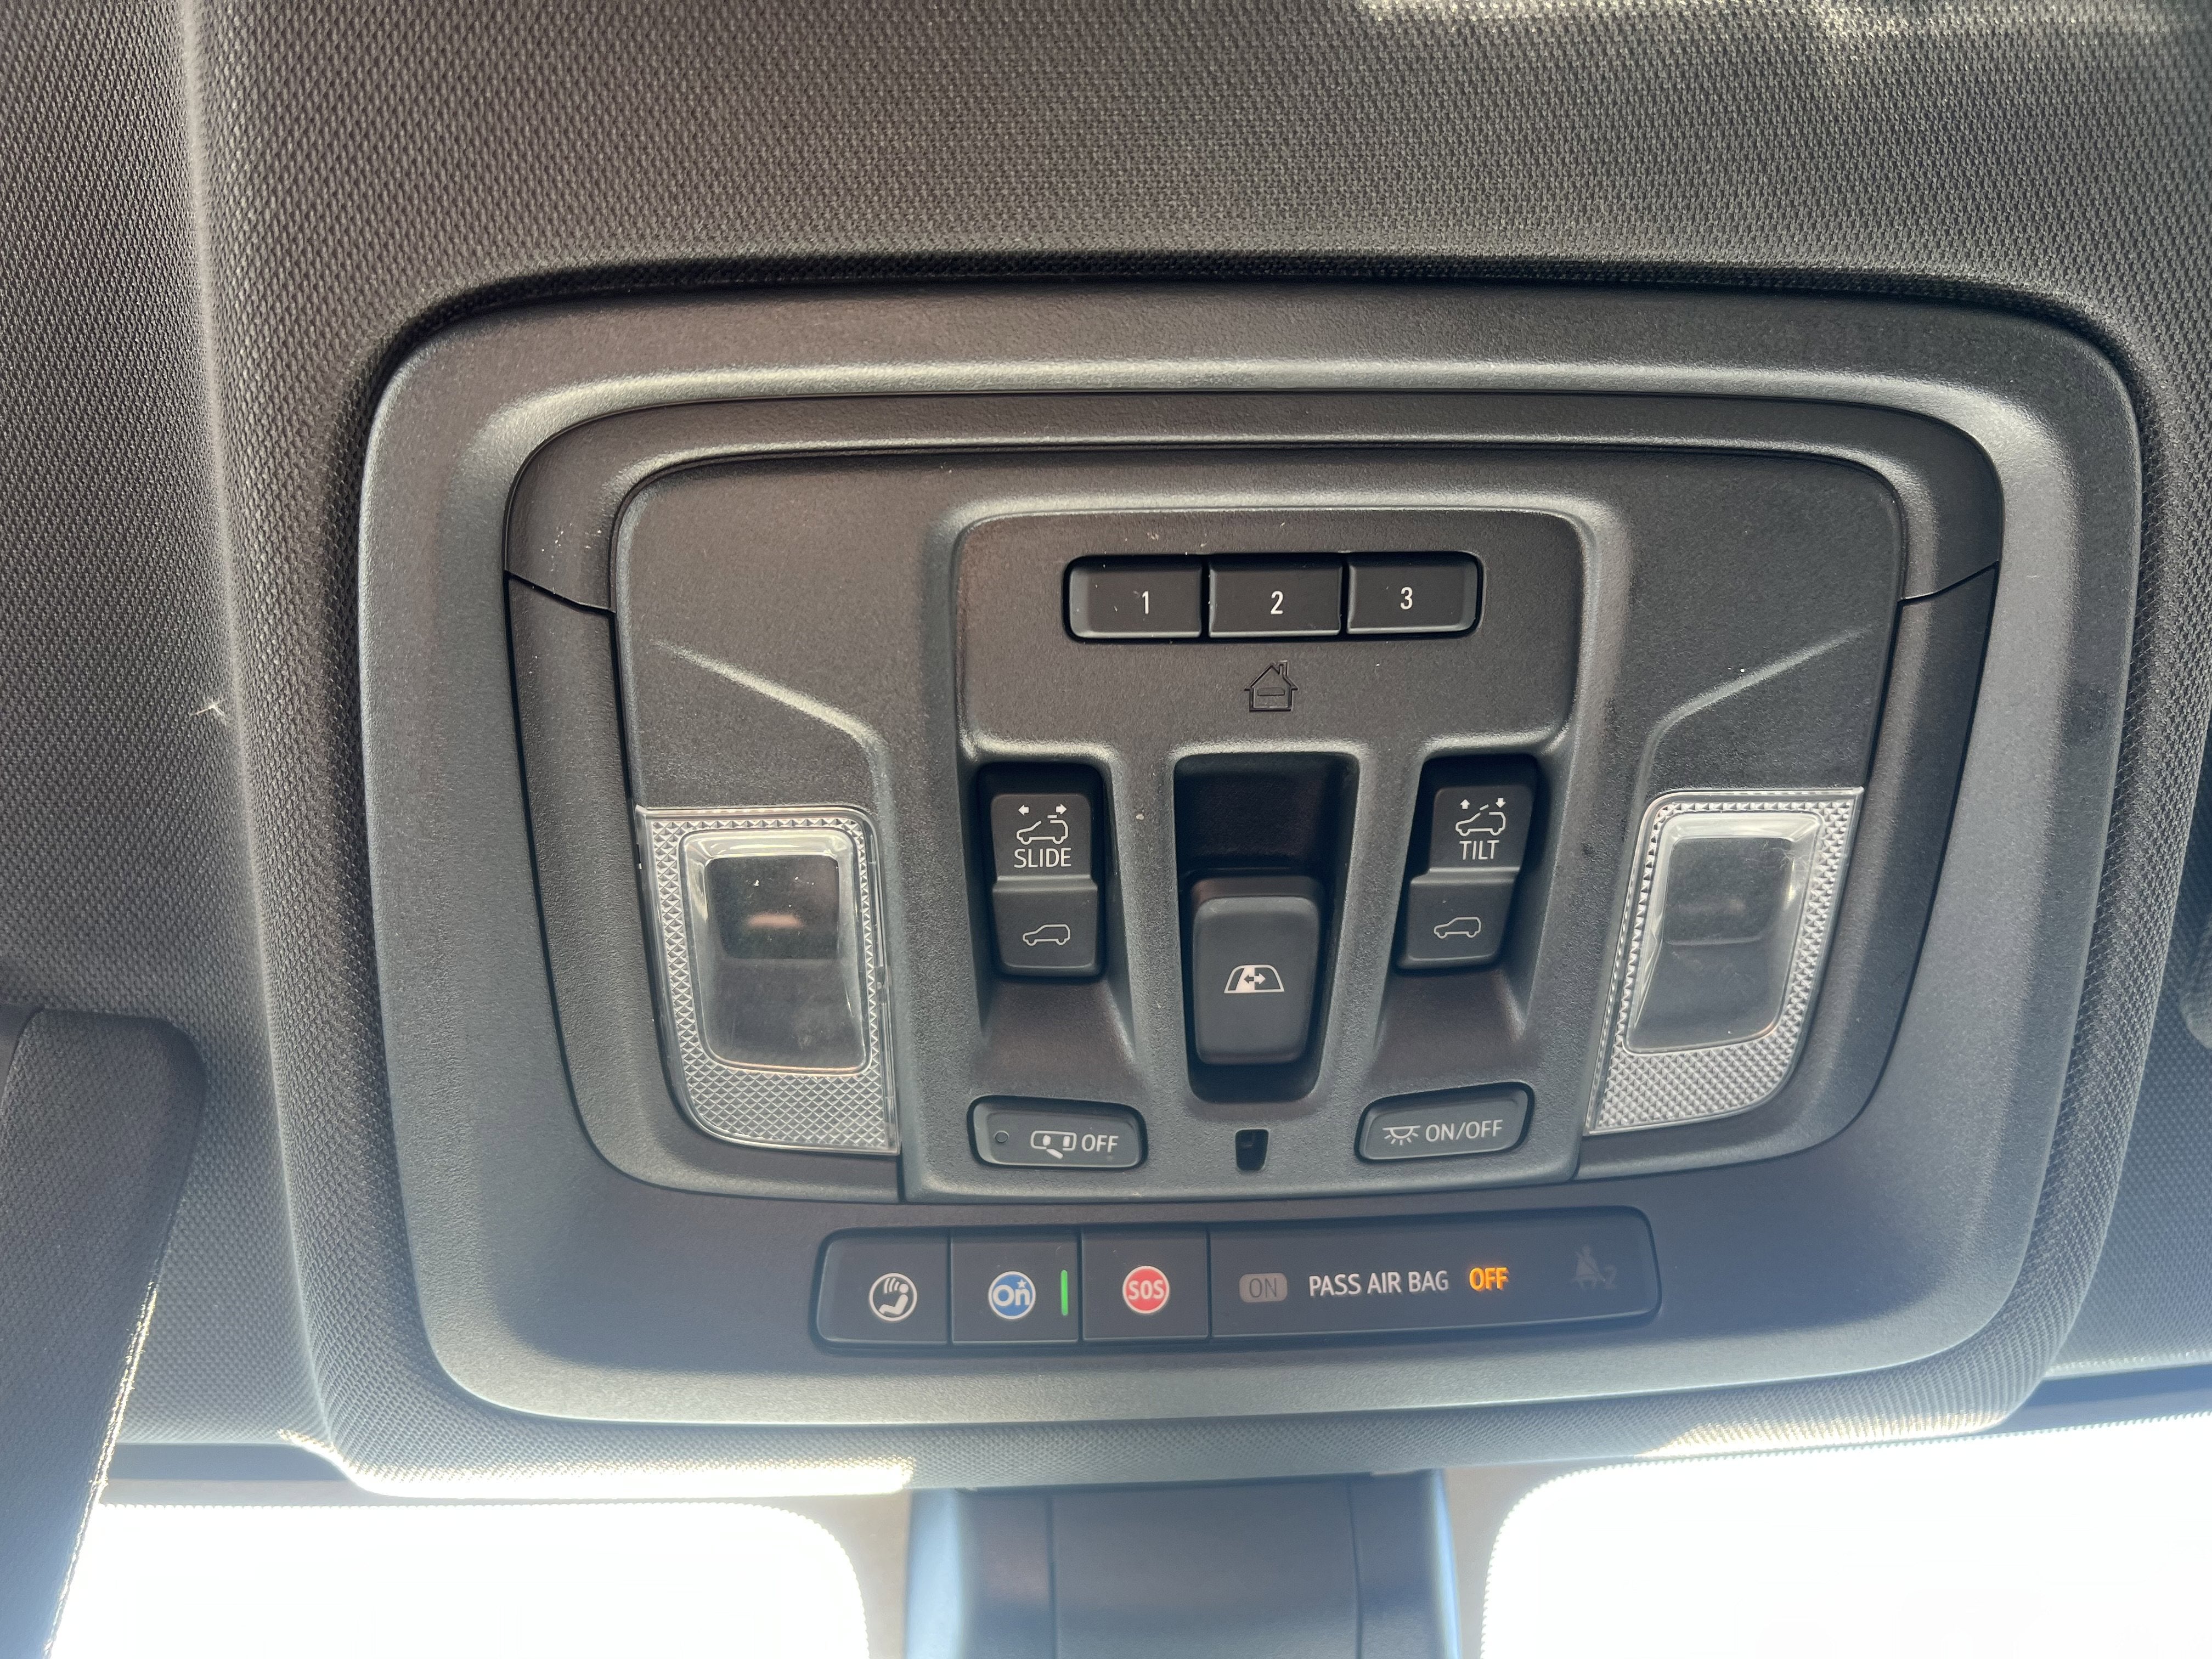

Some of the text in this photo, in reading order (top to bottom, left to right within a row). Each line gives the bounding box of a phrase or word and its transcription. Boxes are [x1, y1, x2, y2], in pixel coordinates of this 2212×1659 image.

[1141, 590, 1149, 614] 1
[1270, 590, 1284, 615] 2
[1400, 586, 1413, 610] 3
[1014, 848, 1071, 868] SLIDE
[1459, 839, 1500, 860] TILT
[1425, 1119, 1504, 1142] ON/OFF
[1081, 1134, 1119, 1153] OFF
[1128, 1279, 1165, 1300] SOS
[1249, 1267, 1509, 1299] ON PASS AIR BAG OFF
[992, 1284, 1031, 1307] On
